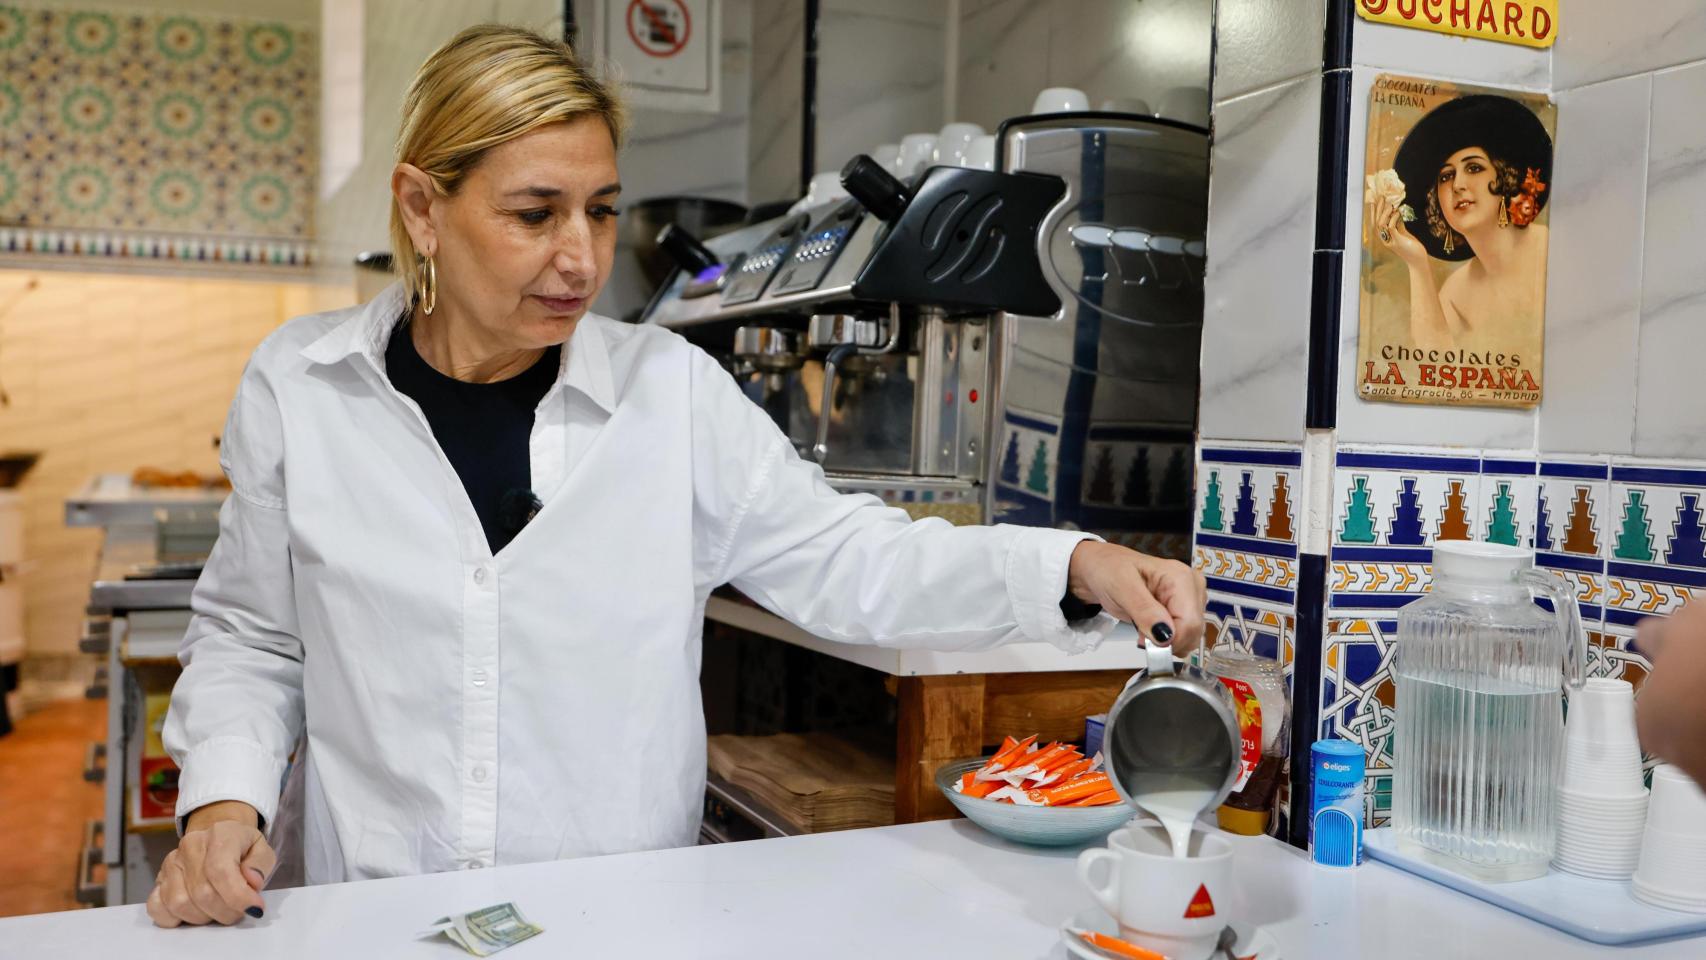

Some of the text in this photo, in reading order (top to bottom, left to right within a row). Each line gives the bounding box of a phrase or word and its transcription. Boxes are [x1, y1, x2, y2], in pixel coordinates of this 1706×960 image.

[1375, 91, 1386, 104] LA
[1363, 361, 1540, 391] LA ESPAÑA
[1492, 391, 1540, 401] MADRID
